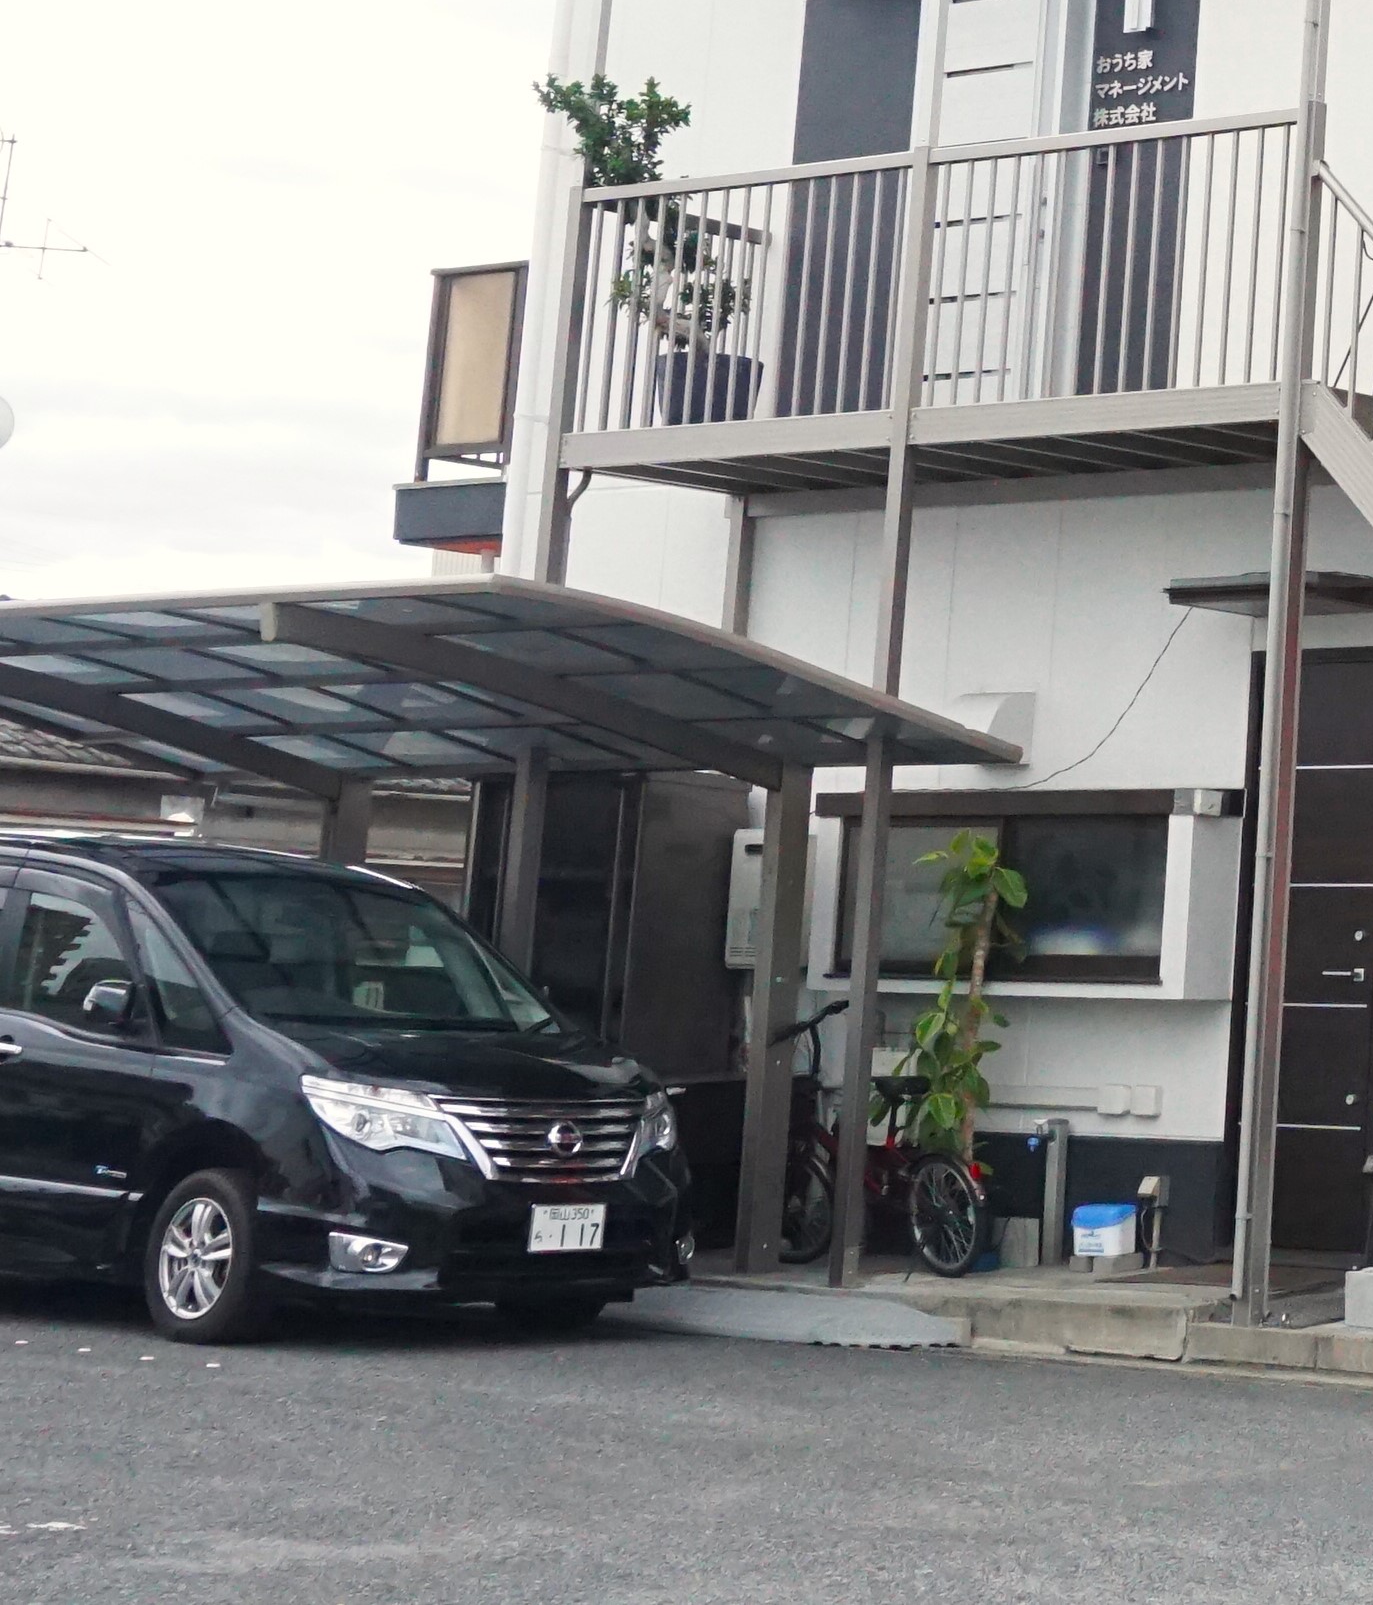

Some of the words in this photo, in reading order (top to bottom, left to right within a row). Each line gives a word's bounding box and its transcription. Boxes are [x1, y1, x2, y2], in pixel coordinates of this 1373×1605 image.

[1096, 49, 1153, 74] おうち家
[1095, 72, 1189, 99] マネージメント
[1093, 101, 1157, 127] 株式会社
